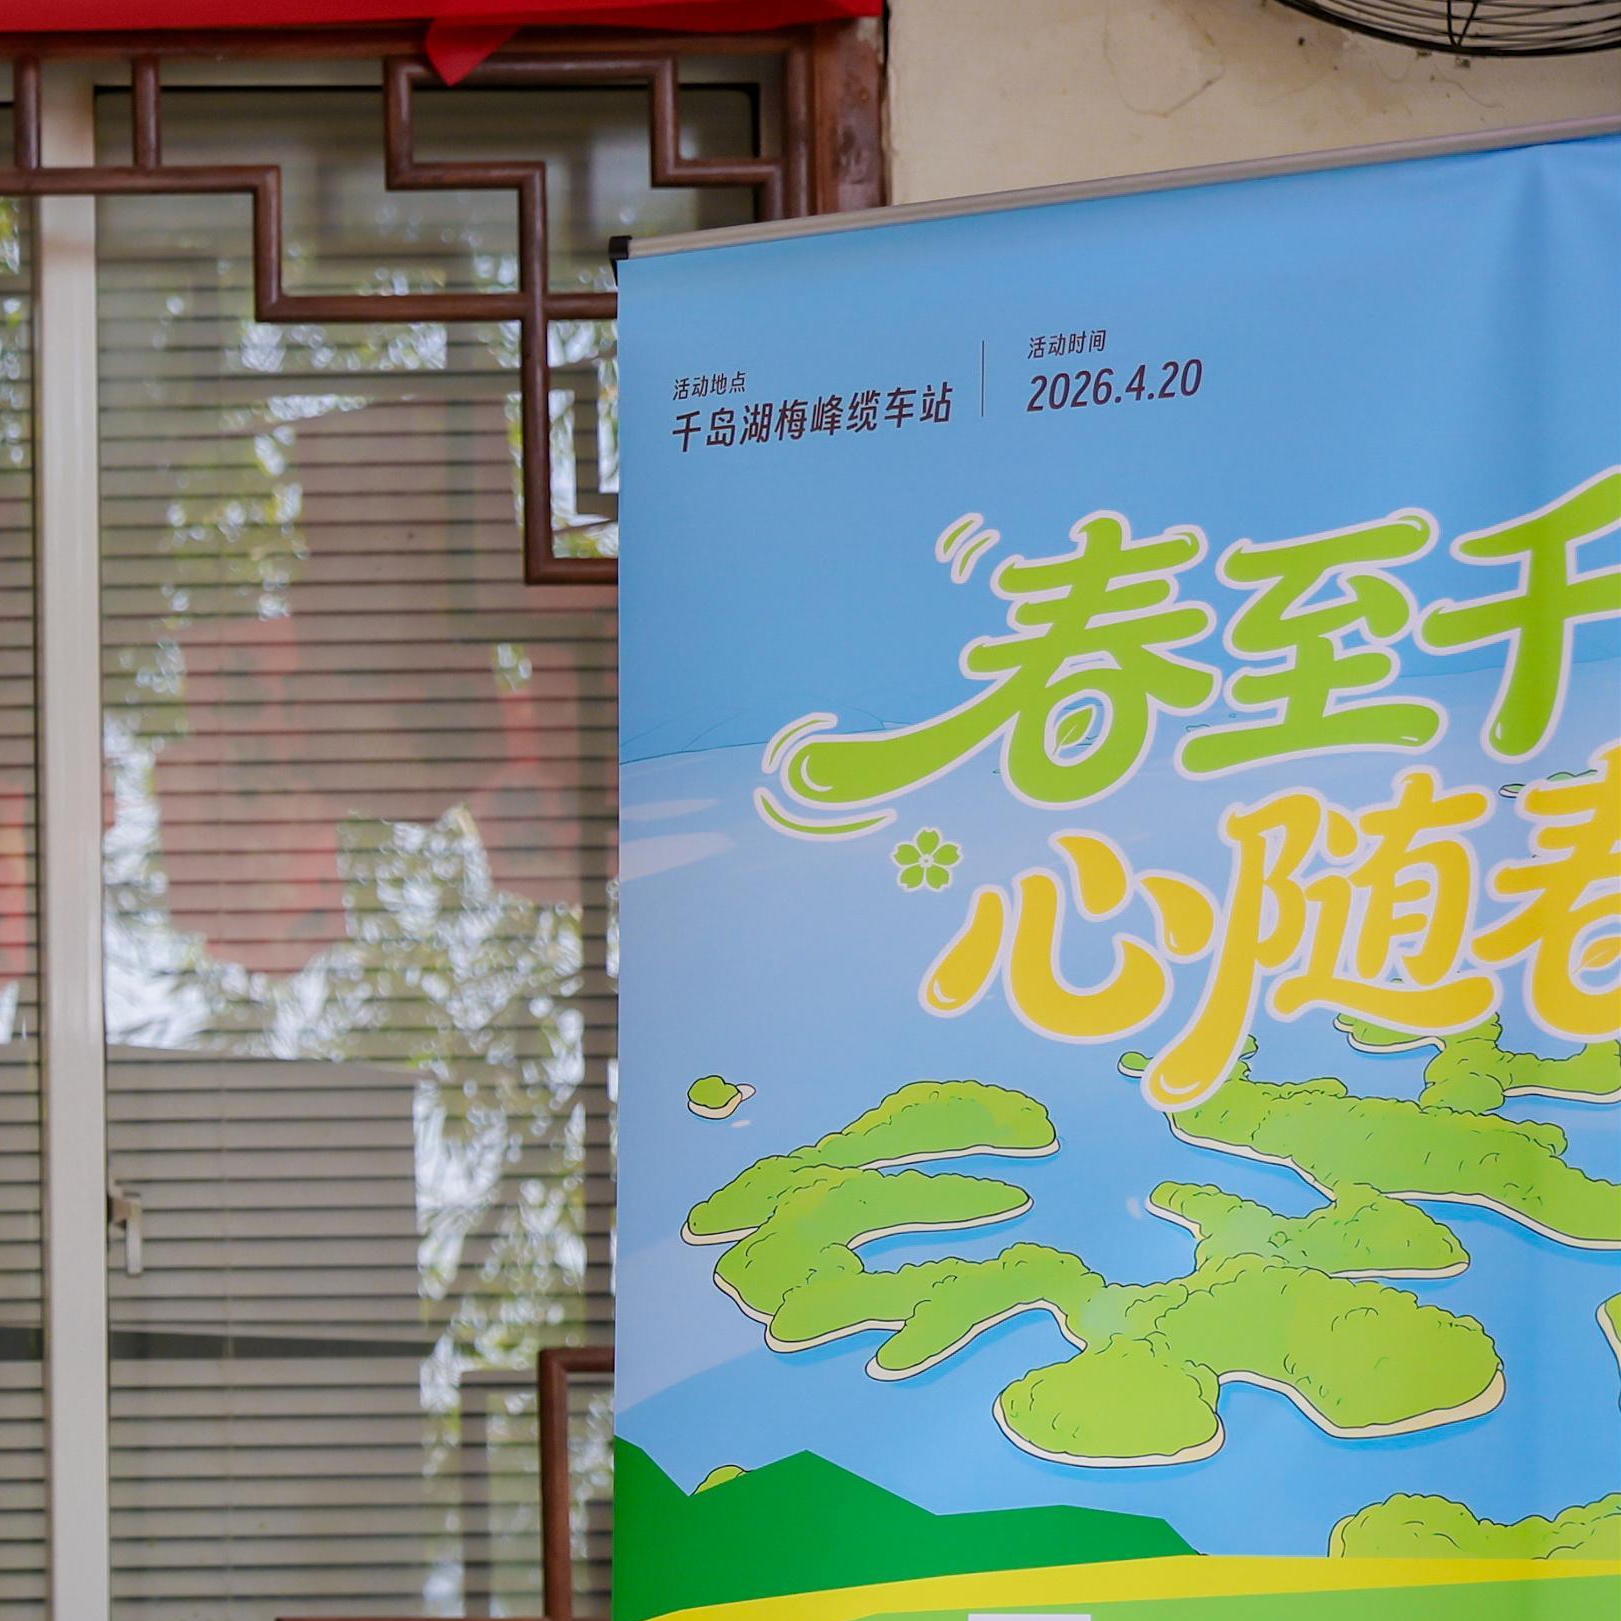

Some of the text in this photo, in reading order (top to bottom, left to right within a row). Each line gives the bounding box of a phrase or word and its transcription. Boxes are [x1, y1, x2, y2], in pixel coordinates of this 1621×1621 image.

[1027, 328, 1107, 359] 活动时间
[672, 370, 747, 400] 活动地点
[1027, 358, 1203, 413] 2026.4.20
[671, 381, 952, 453] 千岛湖梅峰缆车站
